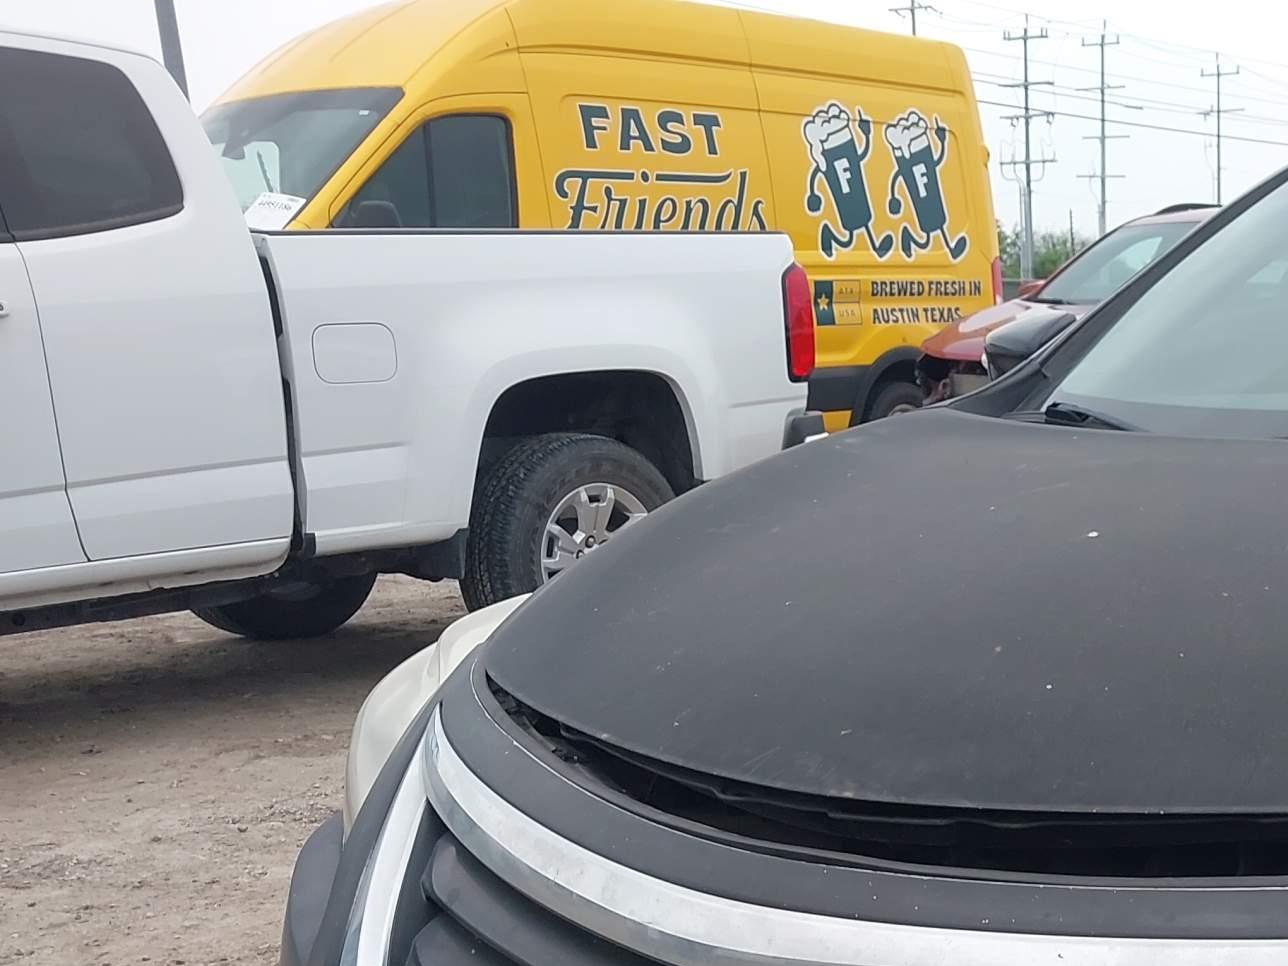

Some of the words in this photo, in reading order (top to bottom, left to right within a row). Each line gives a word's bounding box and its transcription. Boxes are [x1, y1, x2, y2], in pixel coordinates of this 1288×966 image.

[577, 102, 722, 157] FAST
[833, 157, 852, 194] F
[911, 162, 929, 198] F
[554, 168, 768, 231] Friends
[871, 280, 925, 297] BREWED
[928, 280, 966, 297] FRESH
[969, 280, 982, 297] IN
[872, 307, 920, 325] AUSTIN
[923, 306, 961, 325] TEXAS
